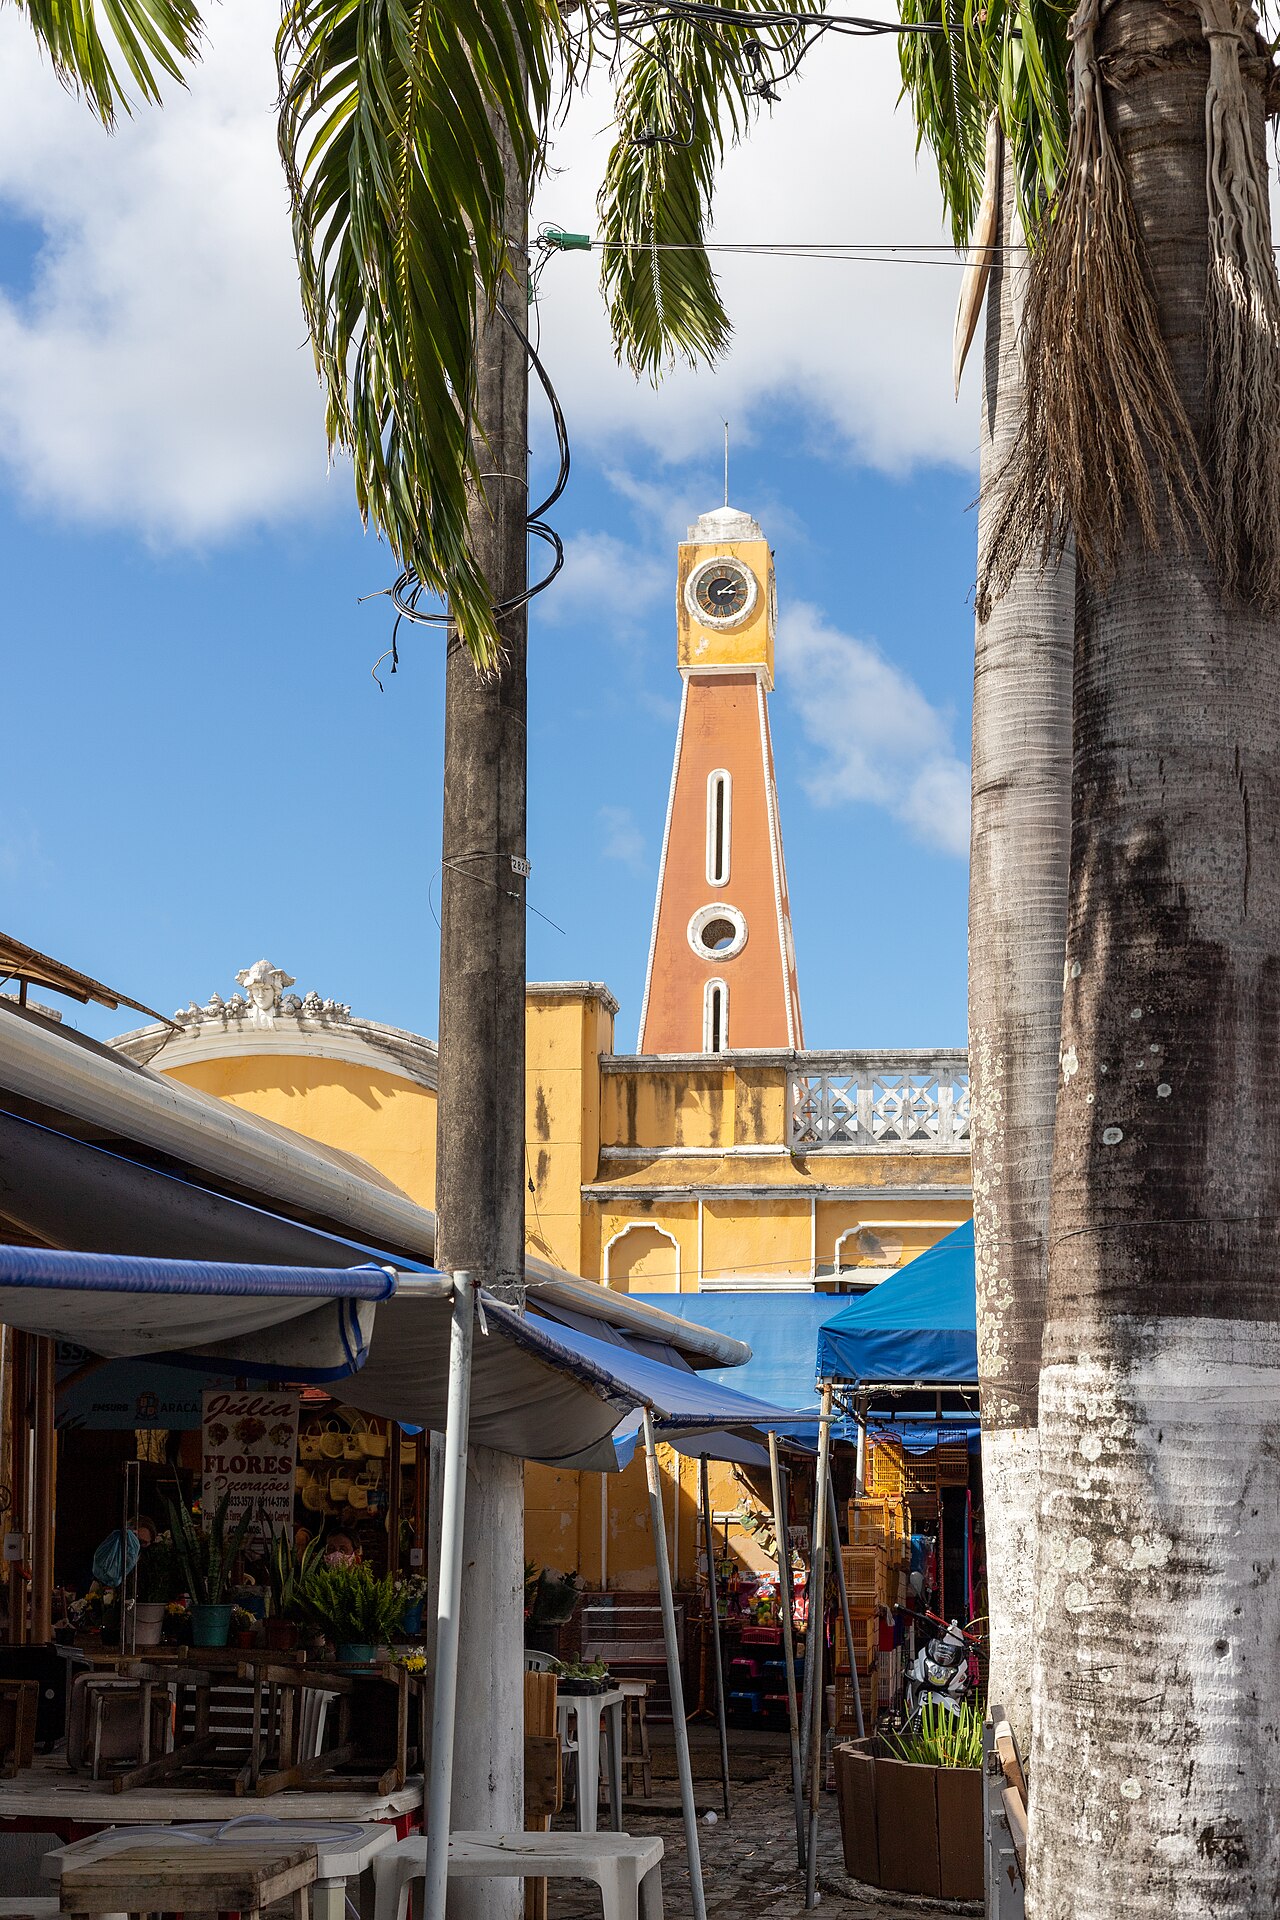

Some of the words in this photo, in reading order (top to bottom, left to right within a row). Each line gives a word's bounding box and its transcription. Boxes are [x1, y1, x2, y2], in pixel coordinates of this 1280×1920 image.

[91, 1403, 129, 1412] EMSURB
[203, 1394, 295, 1424] Júlia
[203, 1455, 293, 1474] FLORES
[214, 1475, 290, 1496] Decorações
